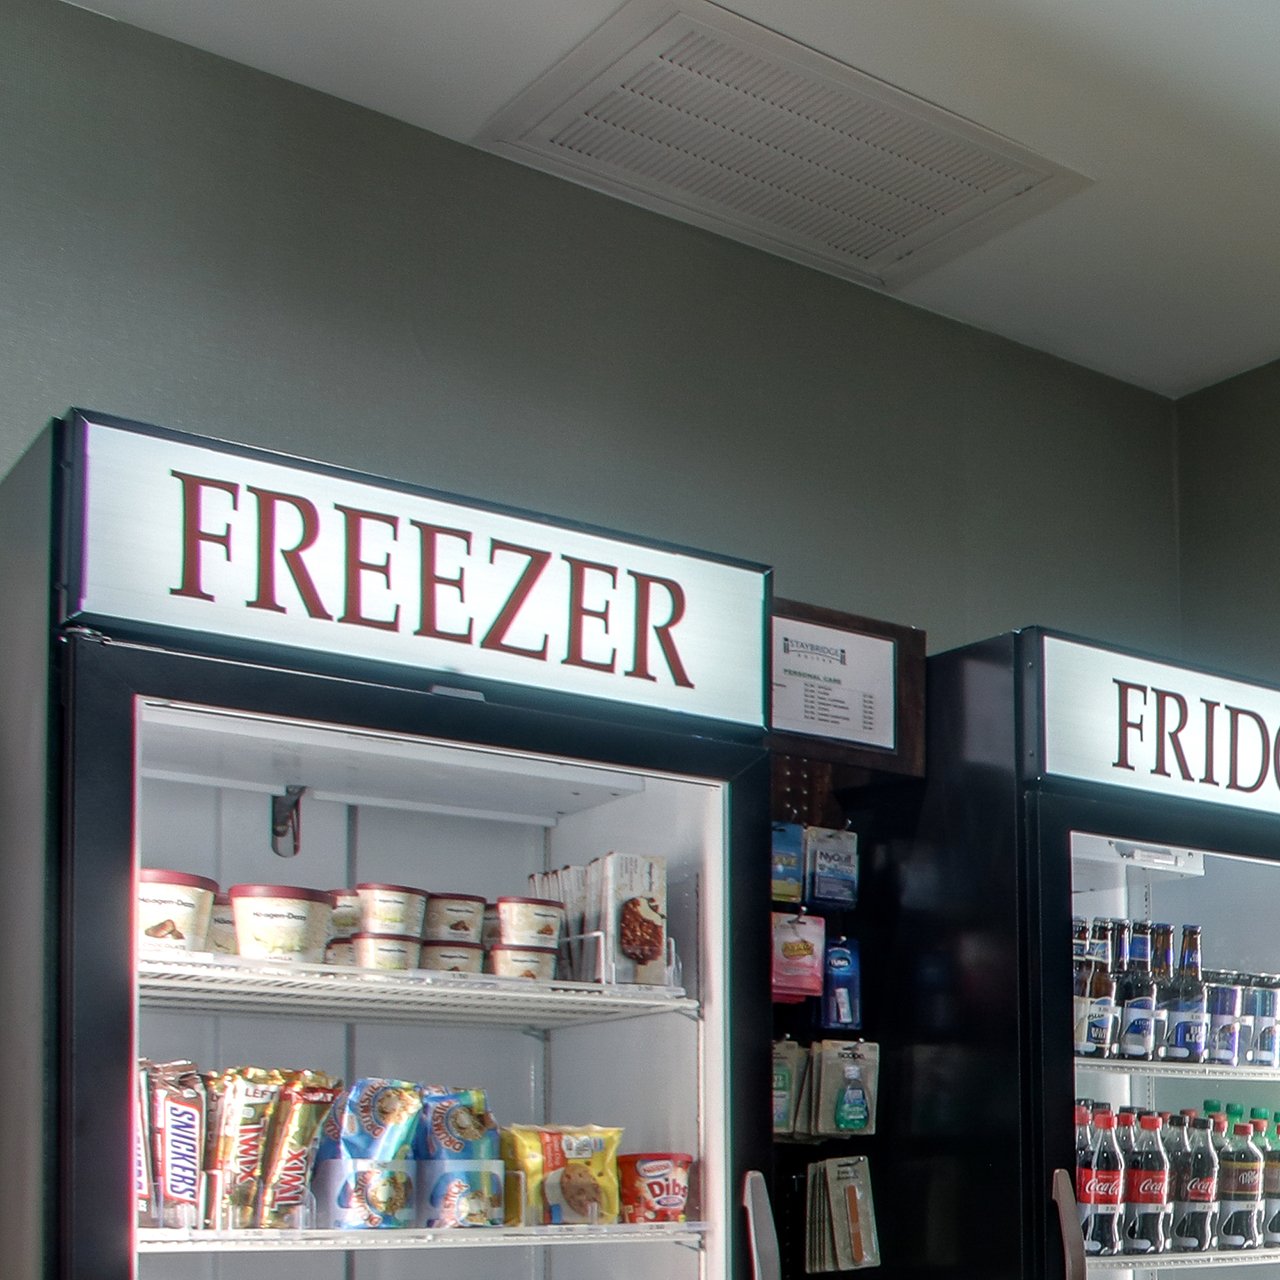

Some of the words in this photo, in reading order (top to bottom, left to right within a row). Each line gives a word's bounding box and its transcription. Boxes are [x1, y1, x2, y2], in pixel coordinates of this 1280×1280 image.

[169, 469, 695, 689] FREEZER
[789, 639, 840, 657] STAYBRIDGE
[783, 668, 821, 681] PERSONAL
[245, 1087, 277, 1100] LEFT
[169, 1104, 197, 1200] SNICKERS
[236, 1116, 268, 1186] TWIX
[270, 1147, 308, 1213] TWIX
[648, 1178, 690, 1198] Dibs
